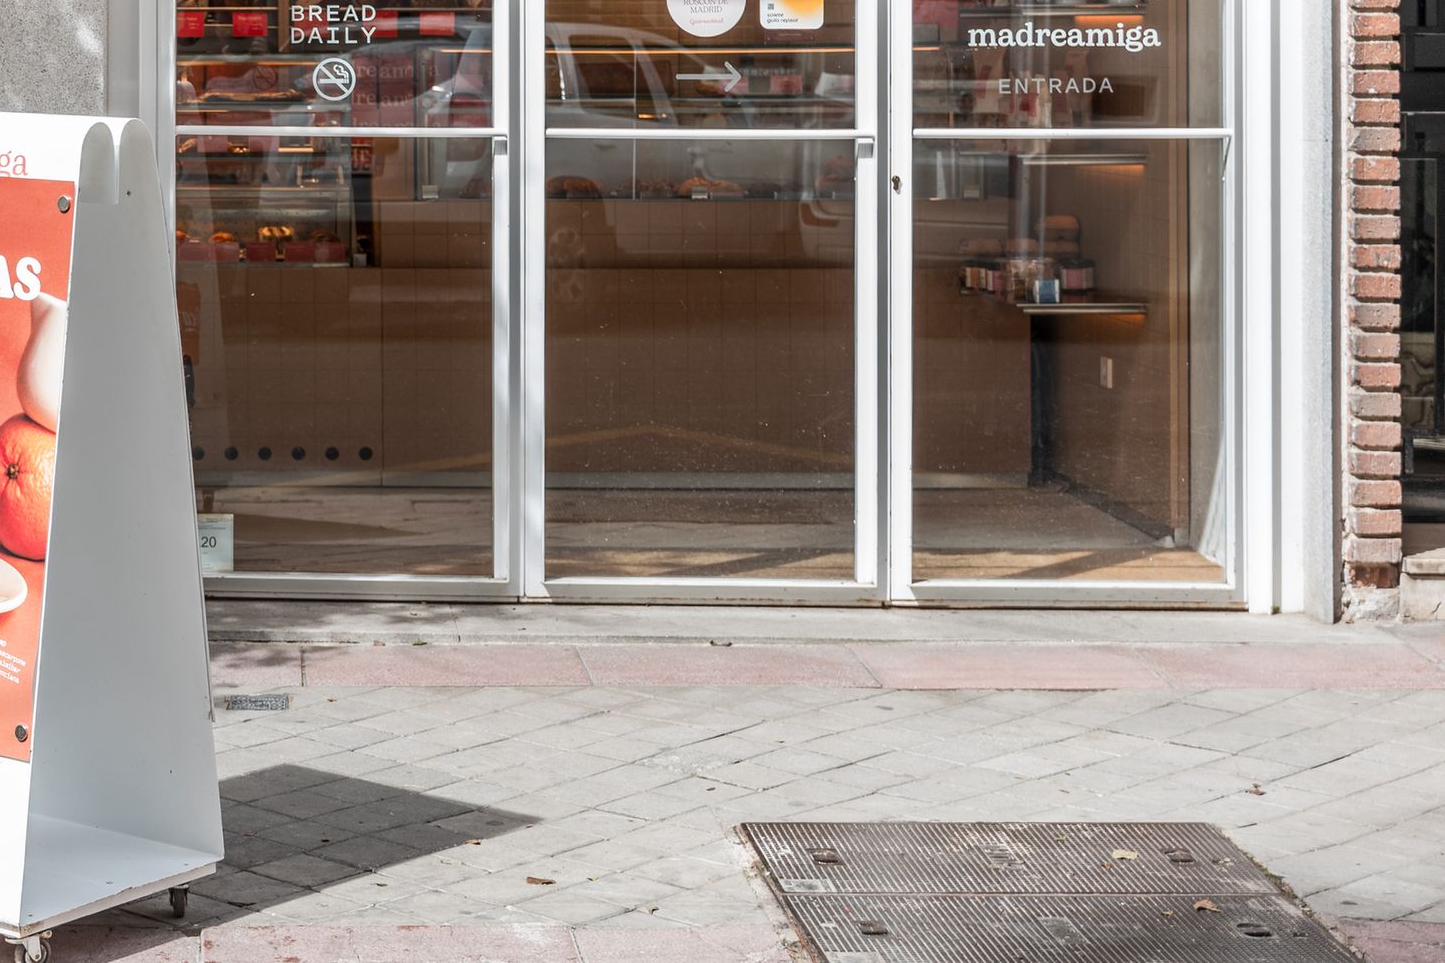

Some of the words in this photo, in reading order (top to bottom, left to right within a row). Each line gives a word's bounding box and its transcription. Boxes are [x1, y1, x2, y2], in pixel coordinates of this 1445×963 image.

[291, 4, 376, 22] BREAD
[690, 6, 722, 14] MADRID
[291, 26, 376, 44] DAILY
[968, 22, 1161, 52] madreamiga
[998, 78, 1114, 94] ENTRADA
